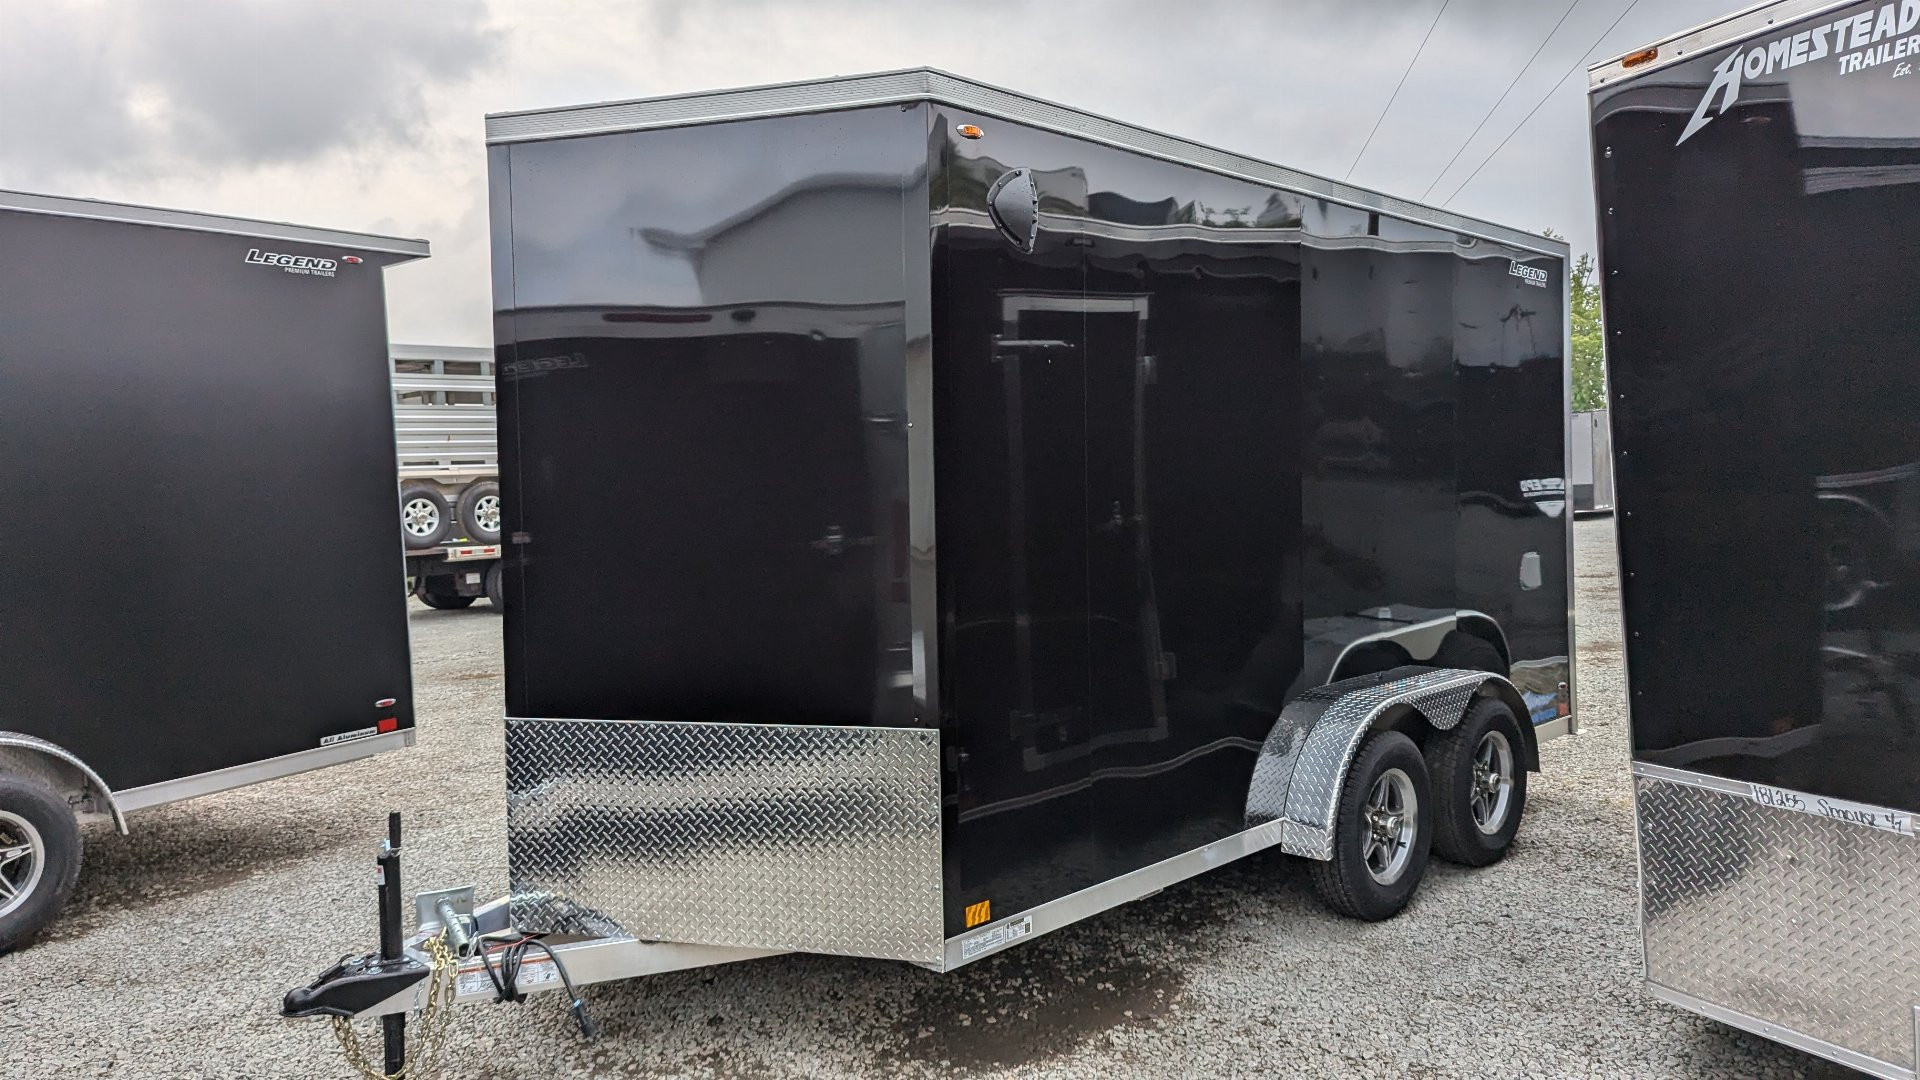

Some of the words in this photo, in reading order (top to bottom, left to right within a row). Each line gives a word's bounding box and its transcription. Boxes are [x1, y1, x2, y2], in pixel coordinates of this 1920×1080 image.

[1676, 0, 1920, 146] HOMESTEAD
[1893, 62, 1912, 78] Est.
[245, 248, 337, 271] LEGEND
[284, 266, 310, 275] PREMIUM
[310, 269, 335, 277] TRAILERS
[1509, 260, 1548, 281] LEGEND
